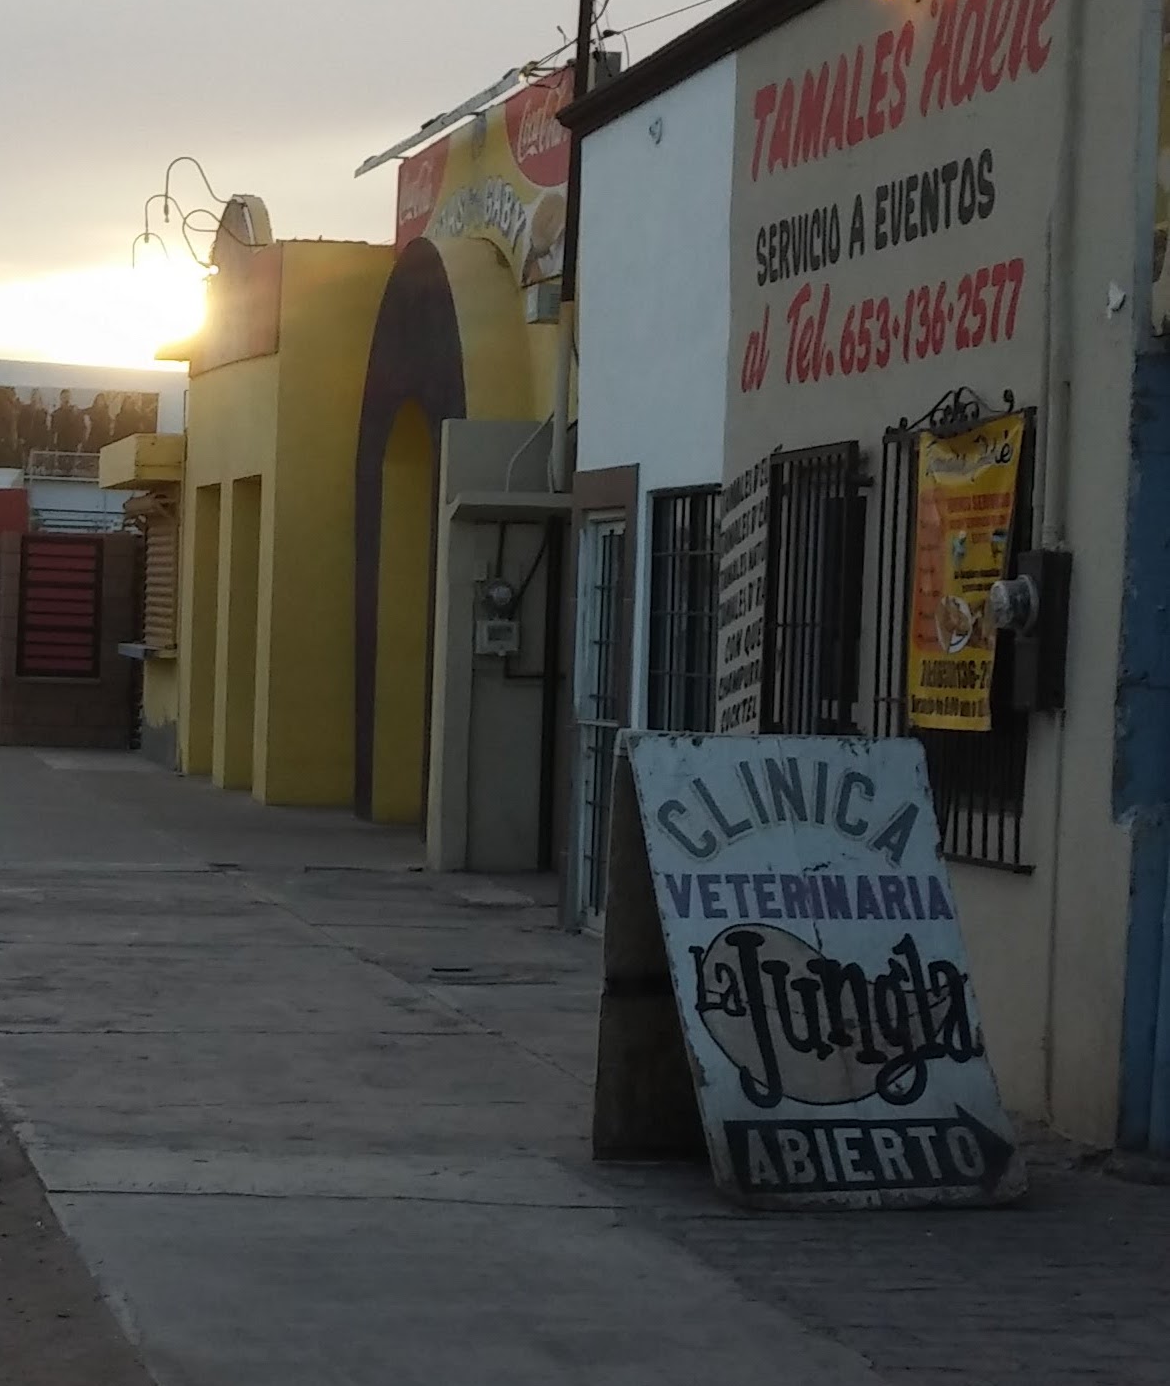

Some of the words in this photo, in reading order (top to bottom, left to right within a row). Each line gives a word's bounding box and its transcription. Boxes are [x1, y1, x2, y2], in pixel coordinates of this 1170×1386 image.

[752, 20, 915, 182] TAMALES
[756, 203, 841, 286] SERVICIO
[848, 193, 866, 259] A
[875, 148, 996, 250] EVENTOS
[657, 756, 921, 867] CLINICA
[665, 874, 955, 921] VETERINARIA
[688, 945, 747, 1017] La
[725, 930, 984, 1108] Jungla
[749, 1126, 987, 1187] ABIERTO
